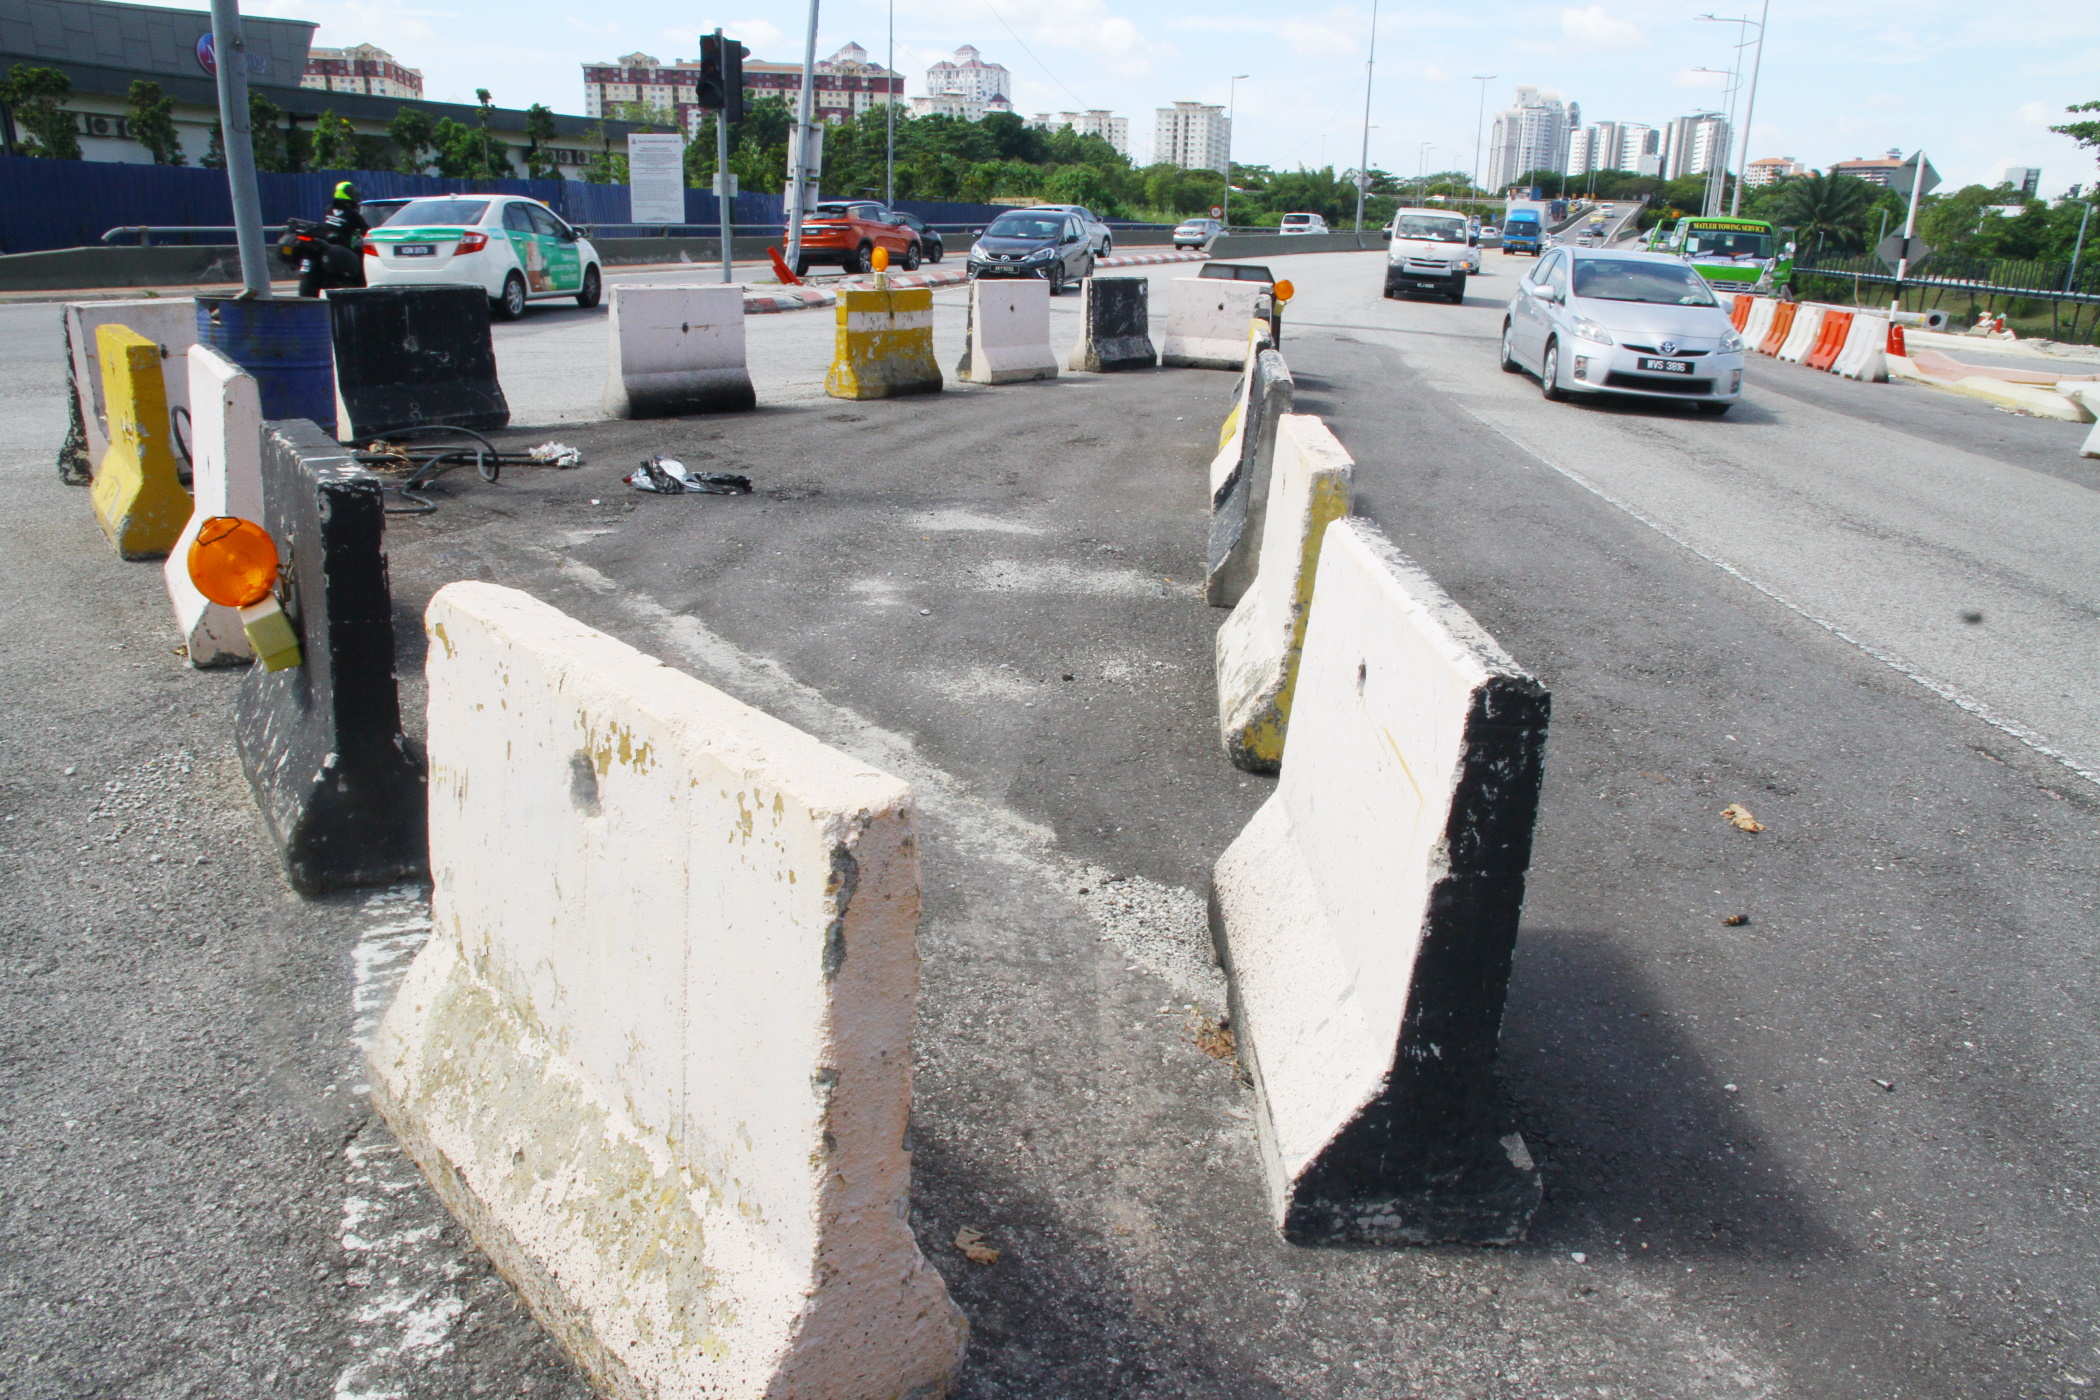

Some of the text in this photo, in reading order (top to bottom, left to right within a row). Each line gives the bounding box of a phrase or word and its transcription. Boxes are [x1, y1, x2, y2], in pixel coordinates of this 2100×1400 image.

[1693, 222, 1766, 233] MATLEH TOWING SERVICE
[1647, 359, 1686, 372] WVS 3816
